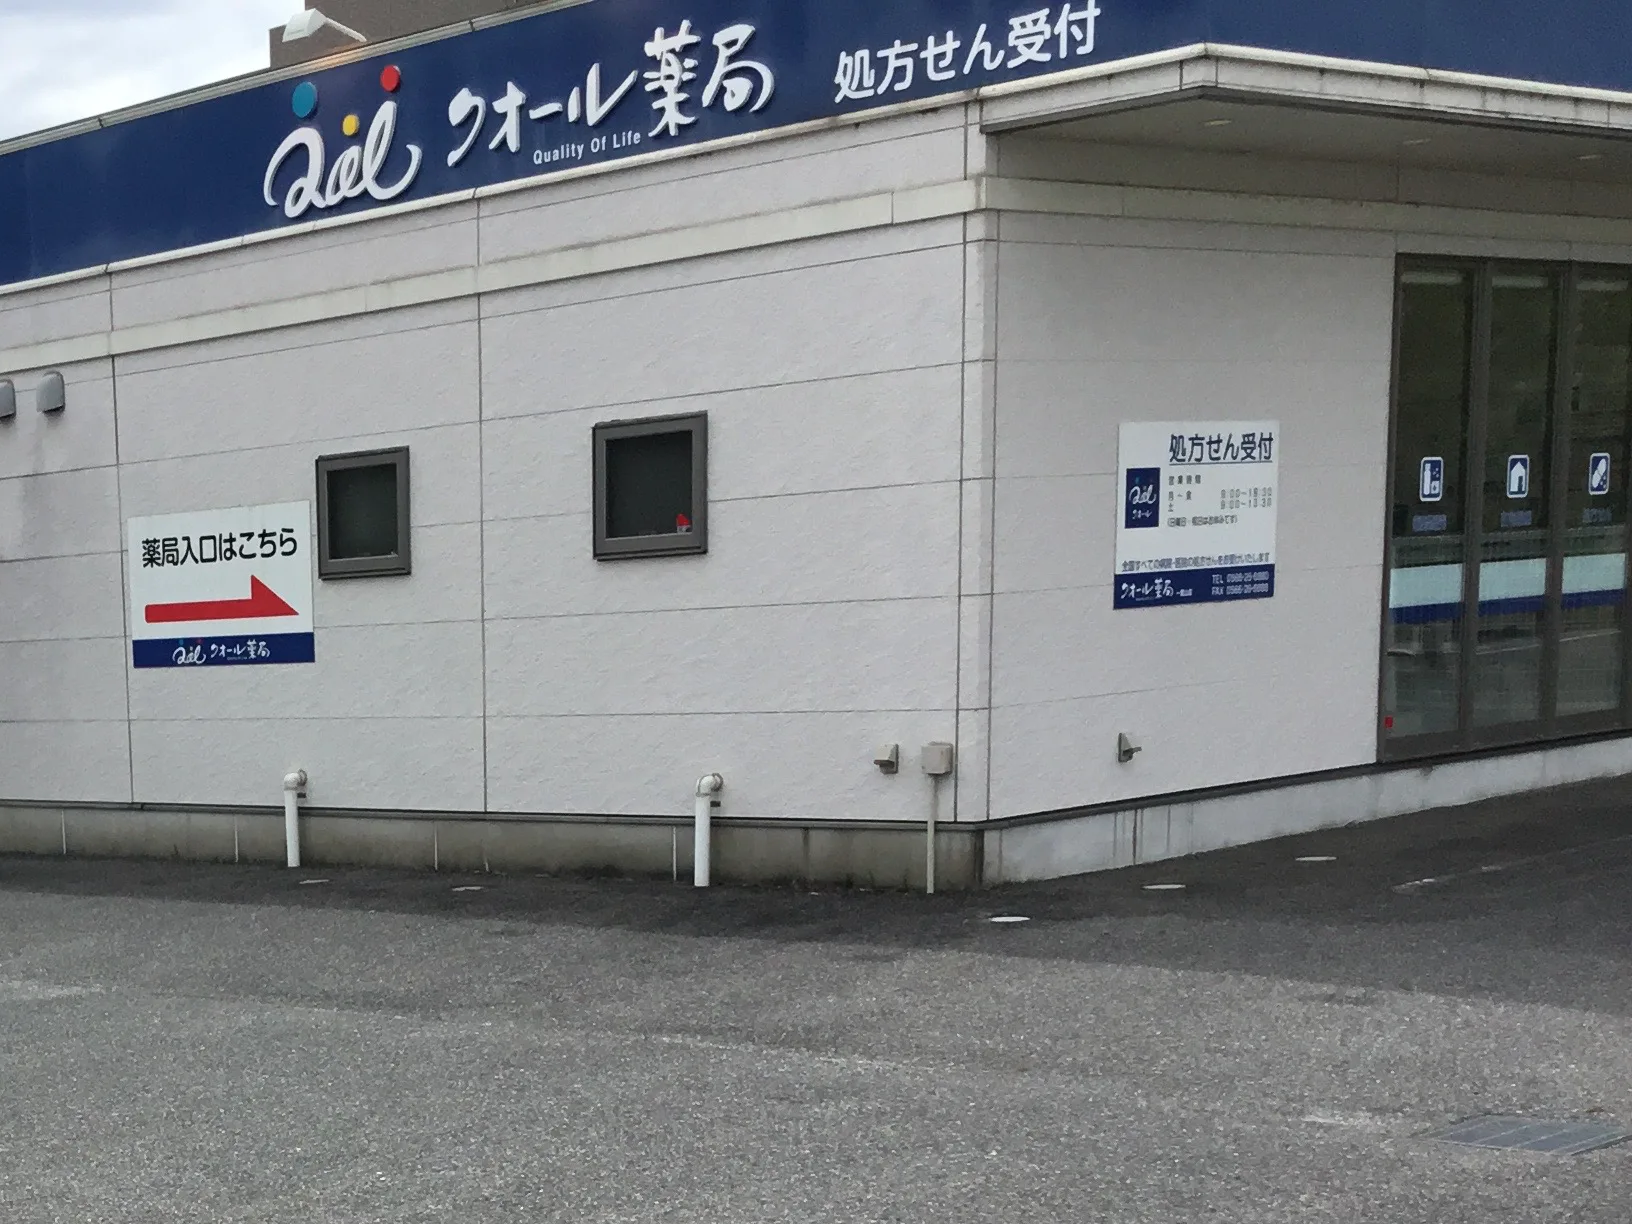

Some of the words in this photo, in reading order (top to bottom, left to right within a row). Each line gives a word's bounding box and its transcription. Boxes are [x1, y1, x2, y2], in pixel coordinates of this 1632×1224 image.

[834, 0, 1101, 103] 処方せん受付
[447, 19, 774, 167] クオール薬局
[533, 143, 584, 165] Quality
[590, 136, 607, 153] Of
[613, 130, 641, 149] Life
[1169, 432, 1274, 463] 処方せん受付
[142, 528, 298, 568] 薬局入口はこちら
[210, 639, 270, 660] クオール薬局
